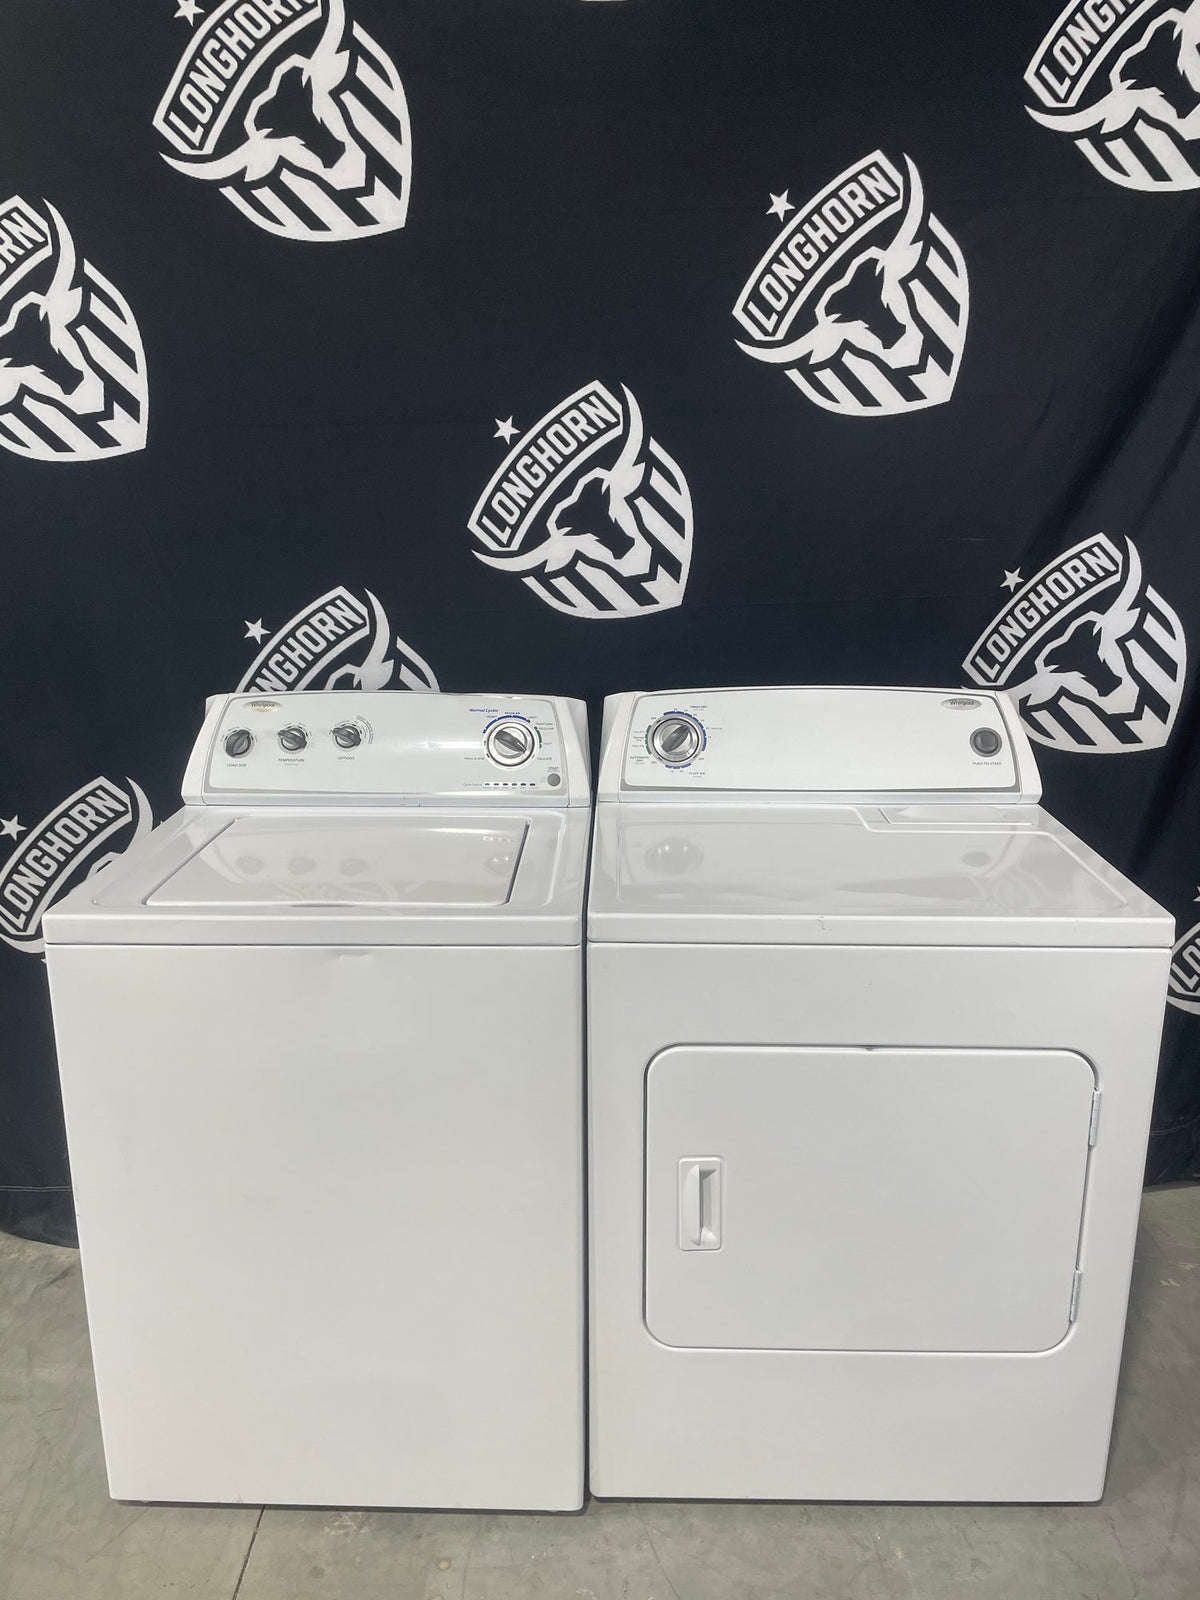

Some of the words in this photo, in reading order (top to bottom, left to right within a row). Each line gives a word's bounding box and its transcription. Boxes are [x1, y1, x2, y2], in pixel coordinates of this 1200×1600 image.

[747, 167, 897, 333] LONGHORN
[482, 395, 617, 544] LONGHORN
[249, 599, 364, 691] NGHORN
[975, 546, 1117, 680] LONGHORN
[0, 790, 126, 929] LONGHORN
